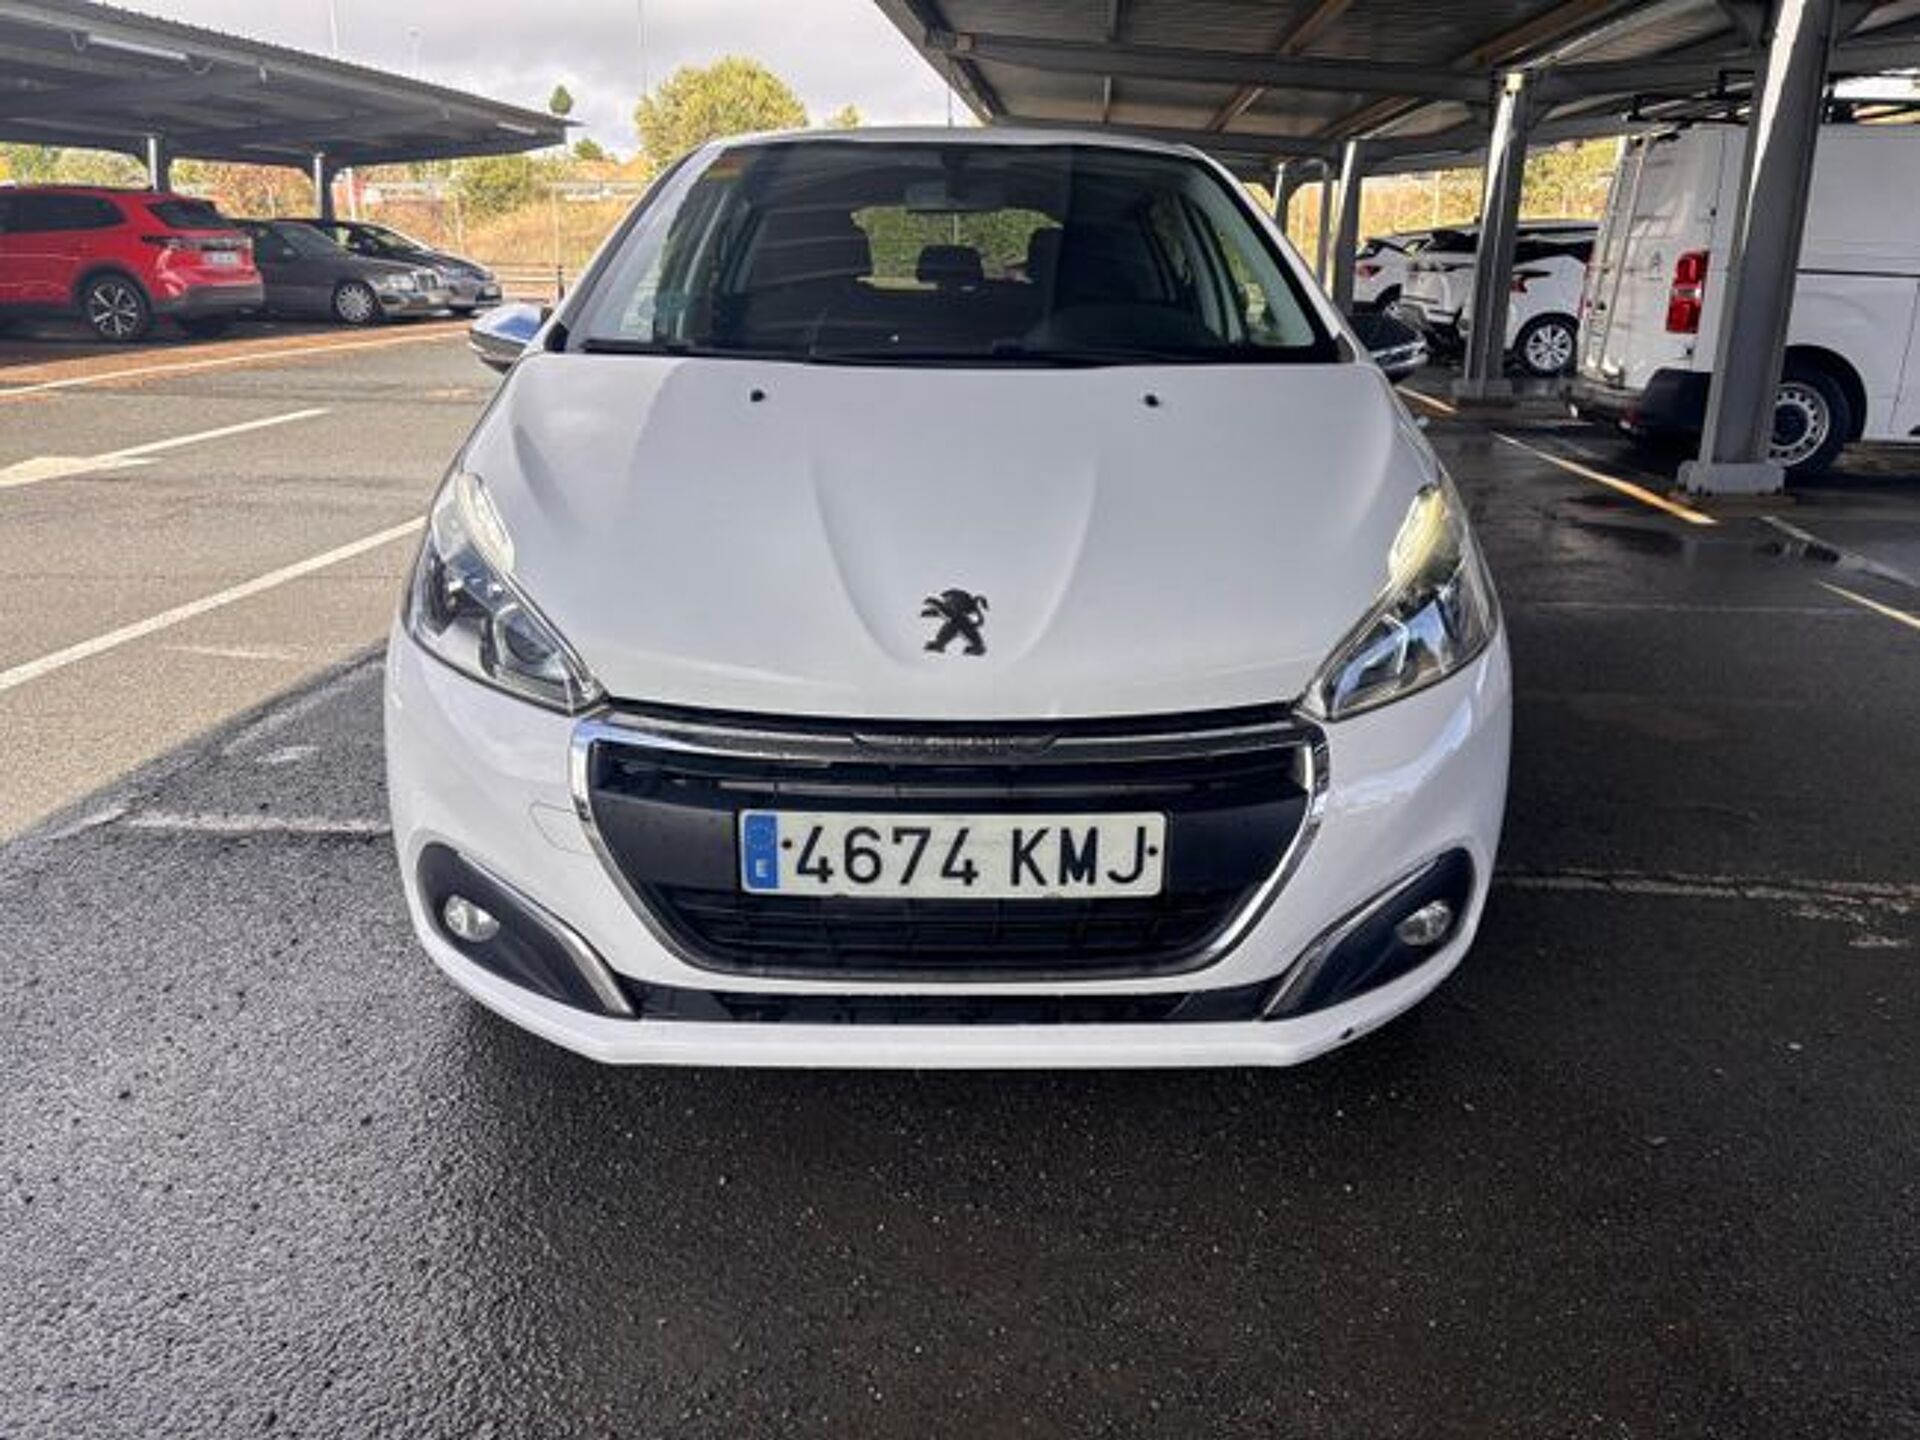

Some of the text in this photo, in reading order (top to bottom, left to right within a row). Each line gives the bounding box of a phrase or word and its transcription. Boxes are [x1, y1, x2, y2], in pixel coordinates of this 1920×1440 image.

[755, 858, 768, 878] E
[796, 825, 1147, 887] 4674 KMJ
